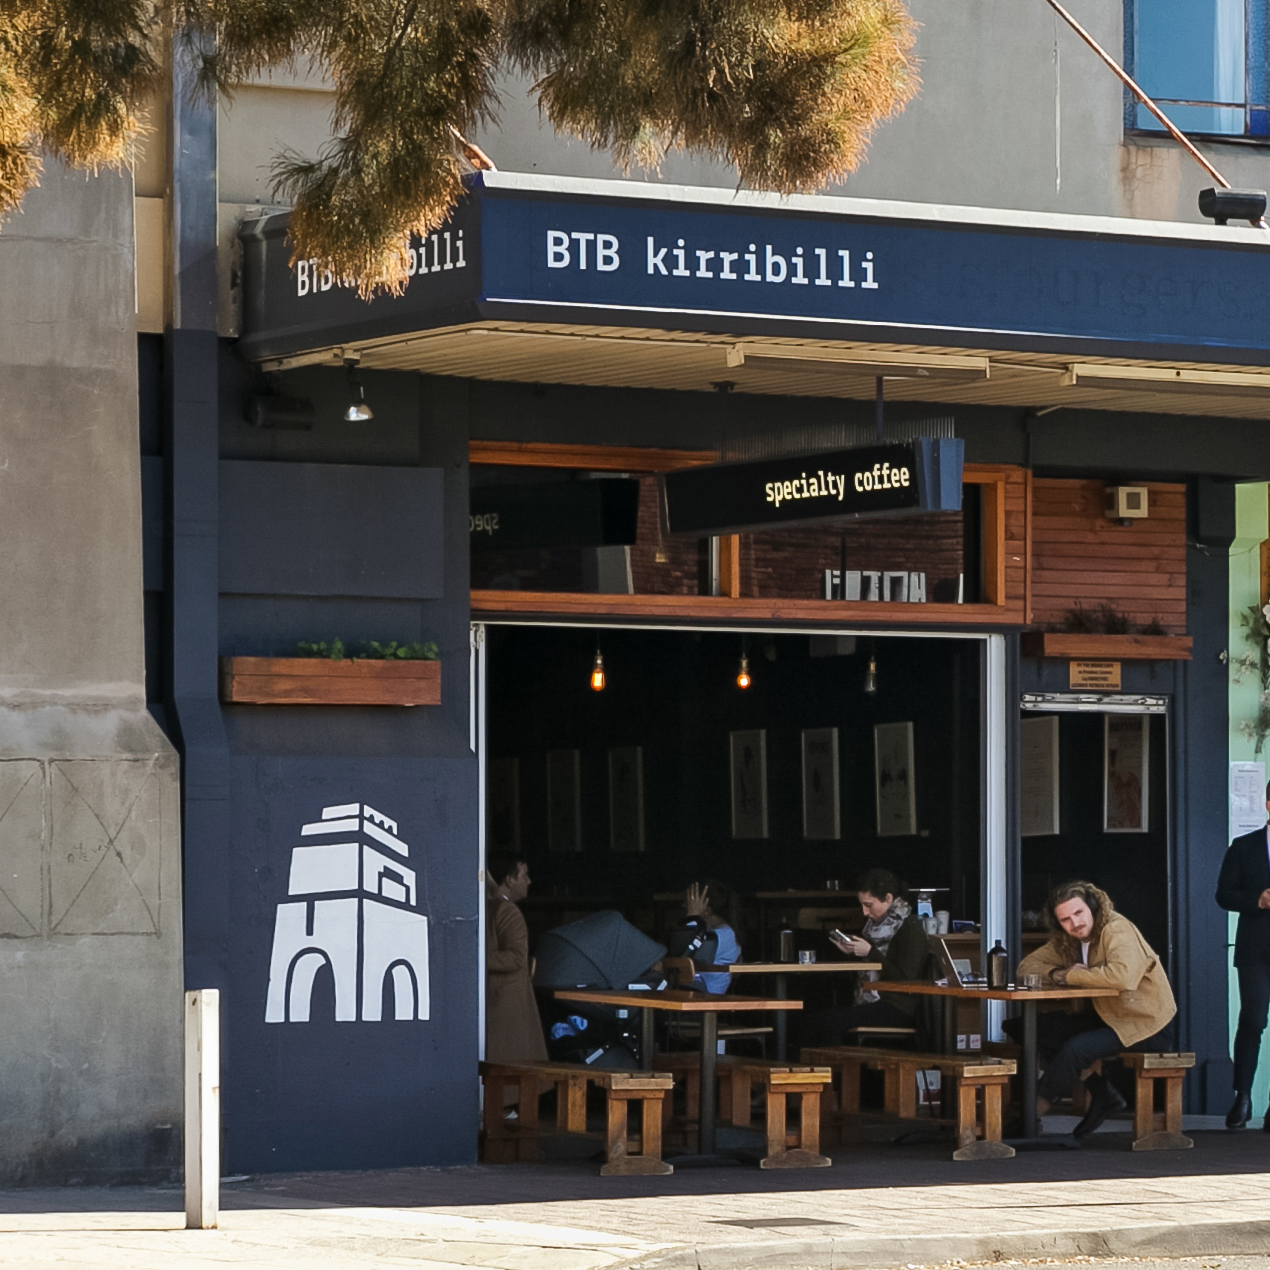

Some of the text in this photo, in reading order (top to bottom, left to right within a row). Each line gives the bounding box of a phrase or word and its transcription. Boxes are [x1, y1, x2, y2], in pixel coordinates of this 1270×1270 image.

[547, 230, 620, 271] BTB
[647, 236, 879, 289] kirribilli
[765, 463, 910, 507] specialty coffee
